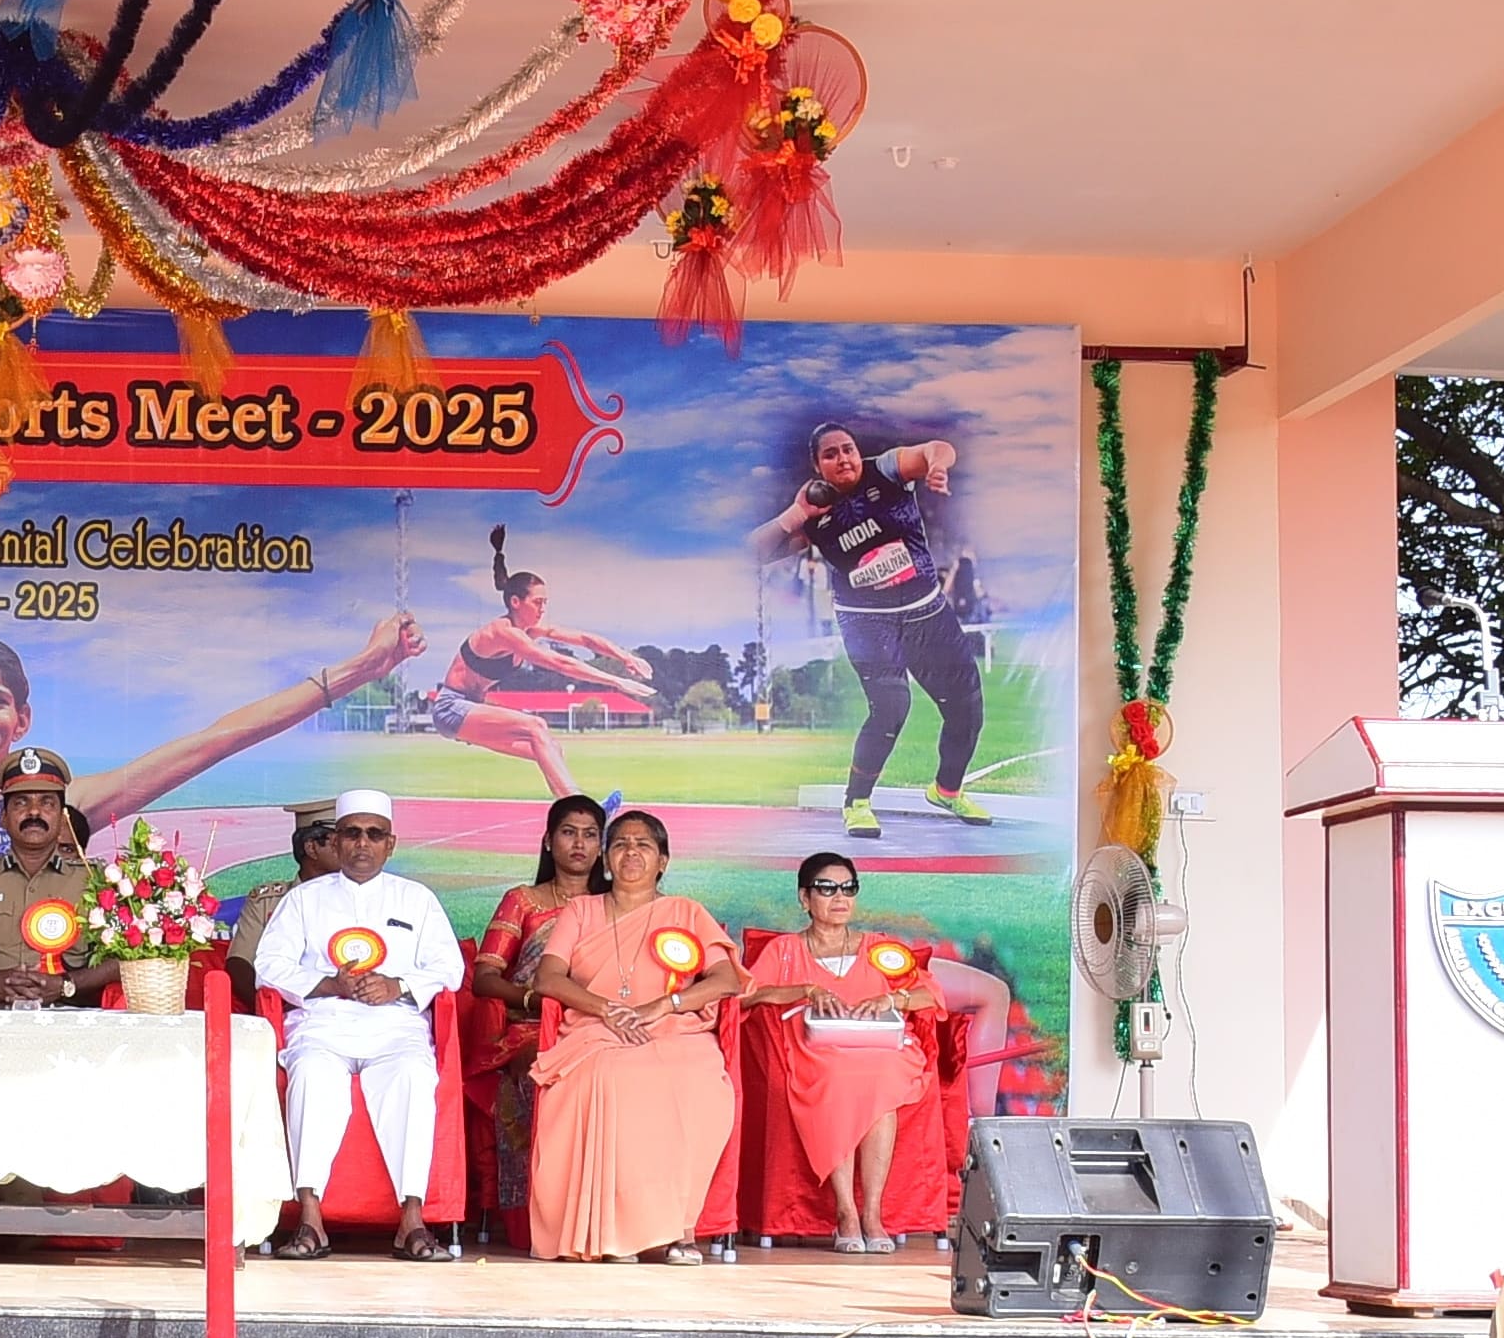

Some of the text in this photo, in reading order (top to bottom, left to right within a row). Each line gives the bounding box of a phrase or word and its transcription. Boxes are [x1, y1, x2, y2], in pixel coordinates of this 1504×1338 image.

[134, 387, 293, 443] Meet
[360, 390, 530, 446] 2025
[79, 520, 311, 570] Celebration
[838, 517, 882, 553] INDIA
[16, 583, 98, 619] 2025
